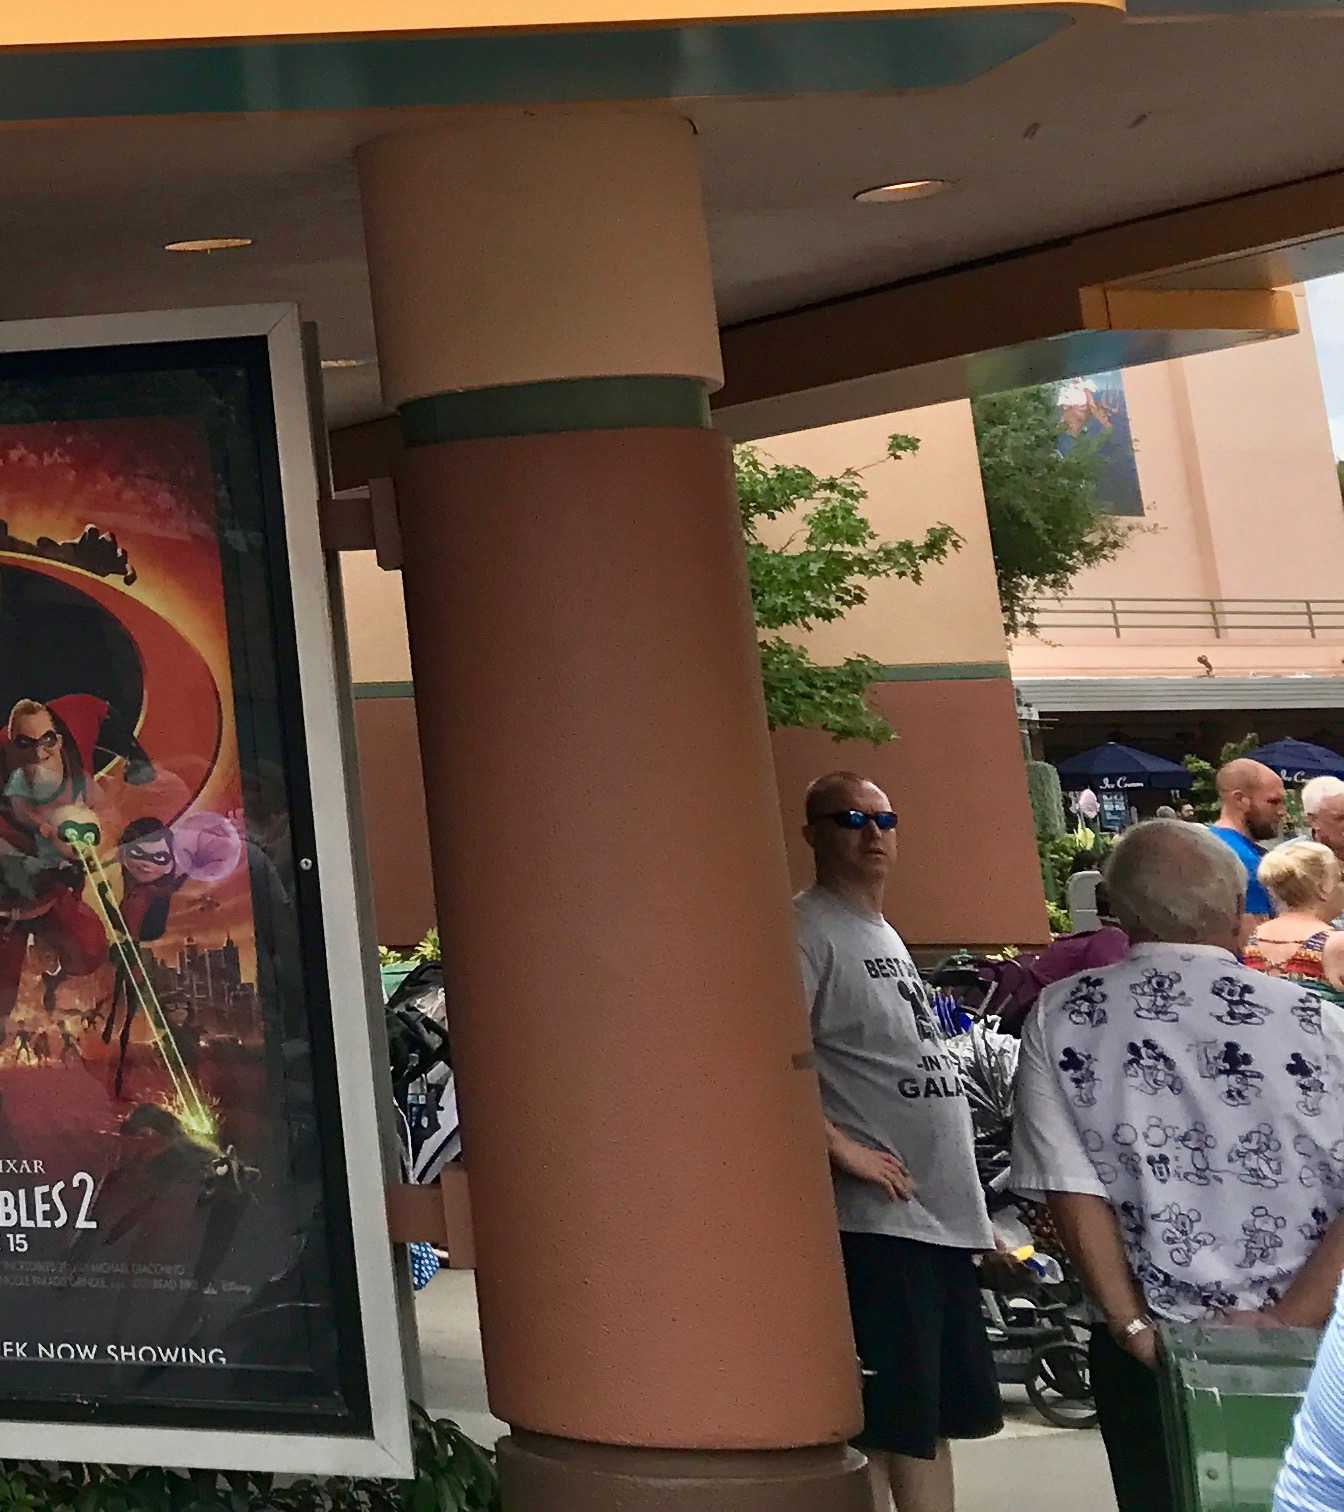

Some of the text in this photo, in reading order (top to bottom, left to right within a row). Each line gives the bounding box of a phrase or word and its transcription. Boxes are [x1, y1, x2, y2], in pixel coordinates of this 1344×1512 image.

[863, 957, 905, 979] BEST
[72, 1171, 98, 1229] 2
[6, 1233, 29, 1252] 15
[37, 1342, 98, 1360] NOW
[106, 1344, 228, 1366] SHOWING
